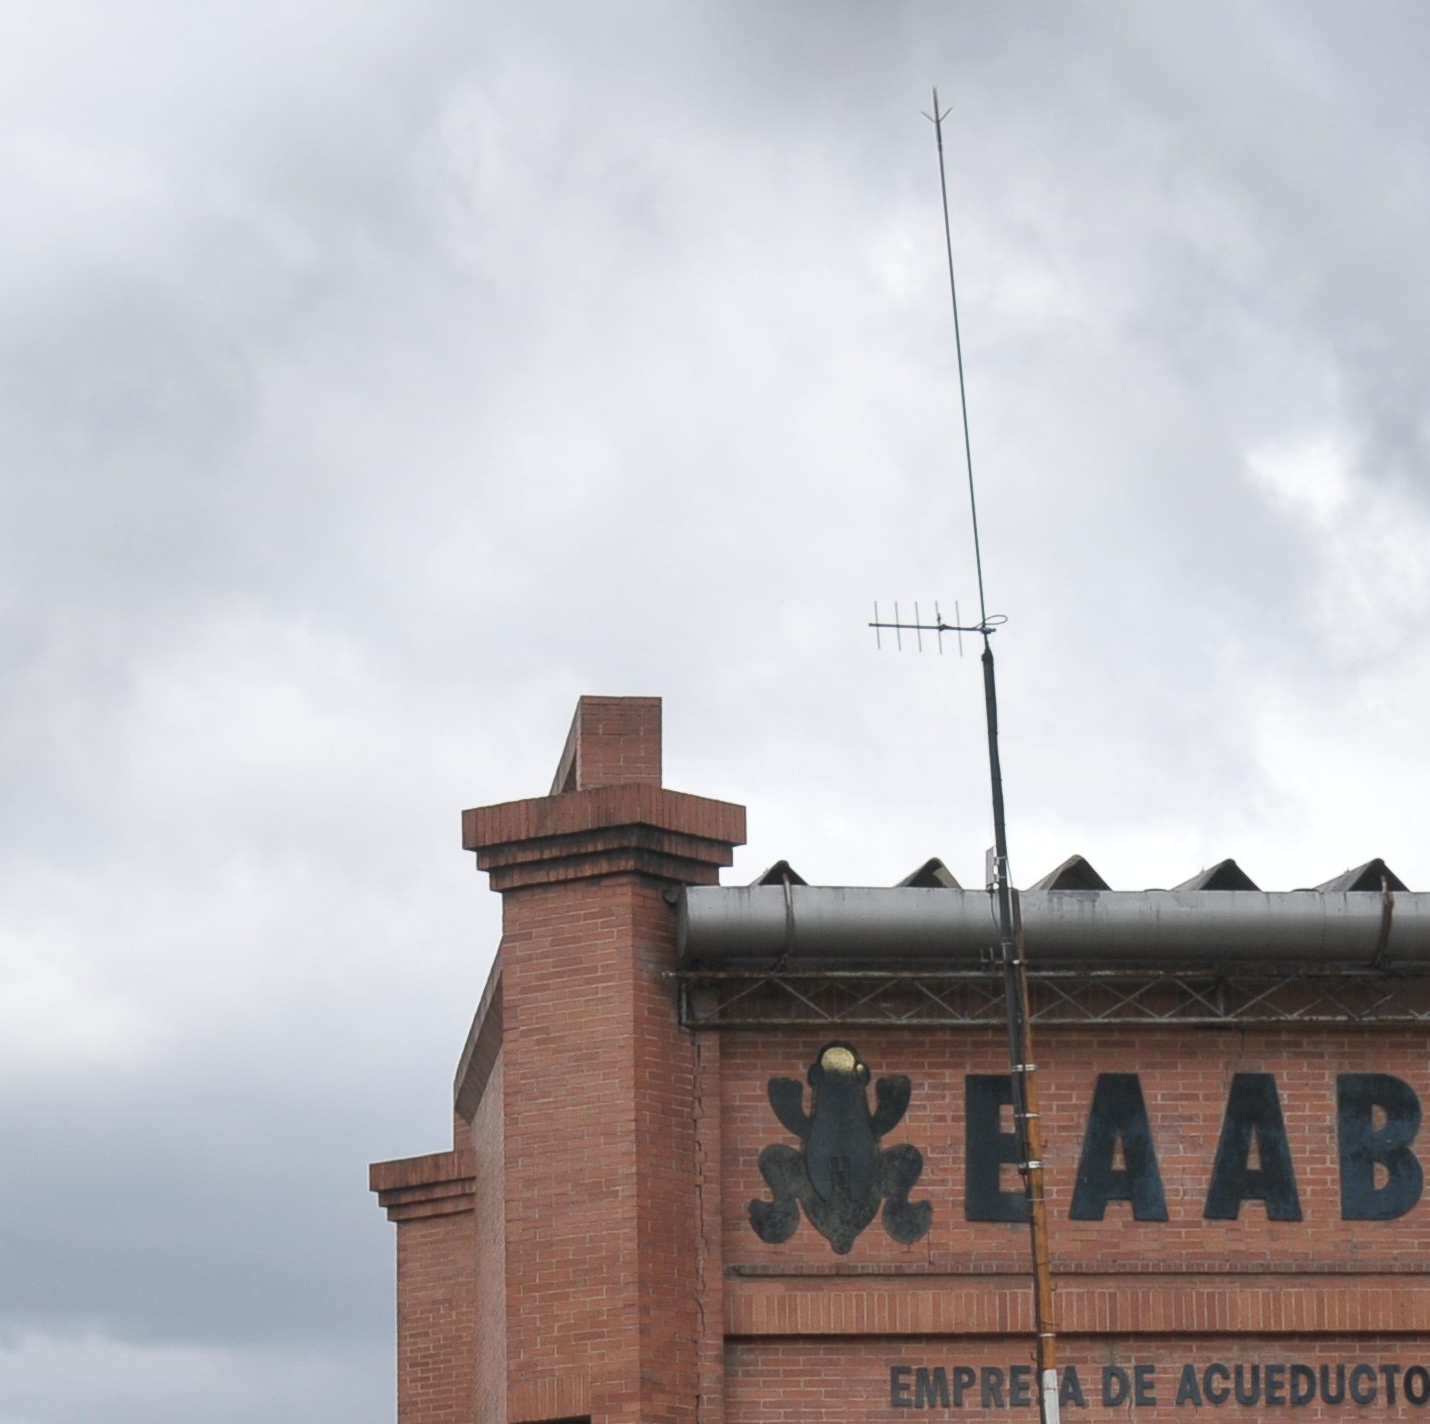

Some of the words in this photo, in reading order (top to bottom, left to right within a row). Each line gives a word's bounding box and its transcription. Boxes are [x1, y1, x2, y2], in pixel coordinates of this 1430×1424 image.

[965, 1072, 1424, 1222] EAAB
[890, 1364, 1085, 1409] EMPREA
[1101, 1364, 1157, 1408] DE
